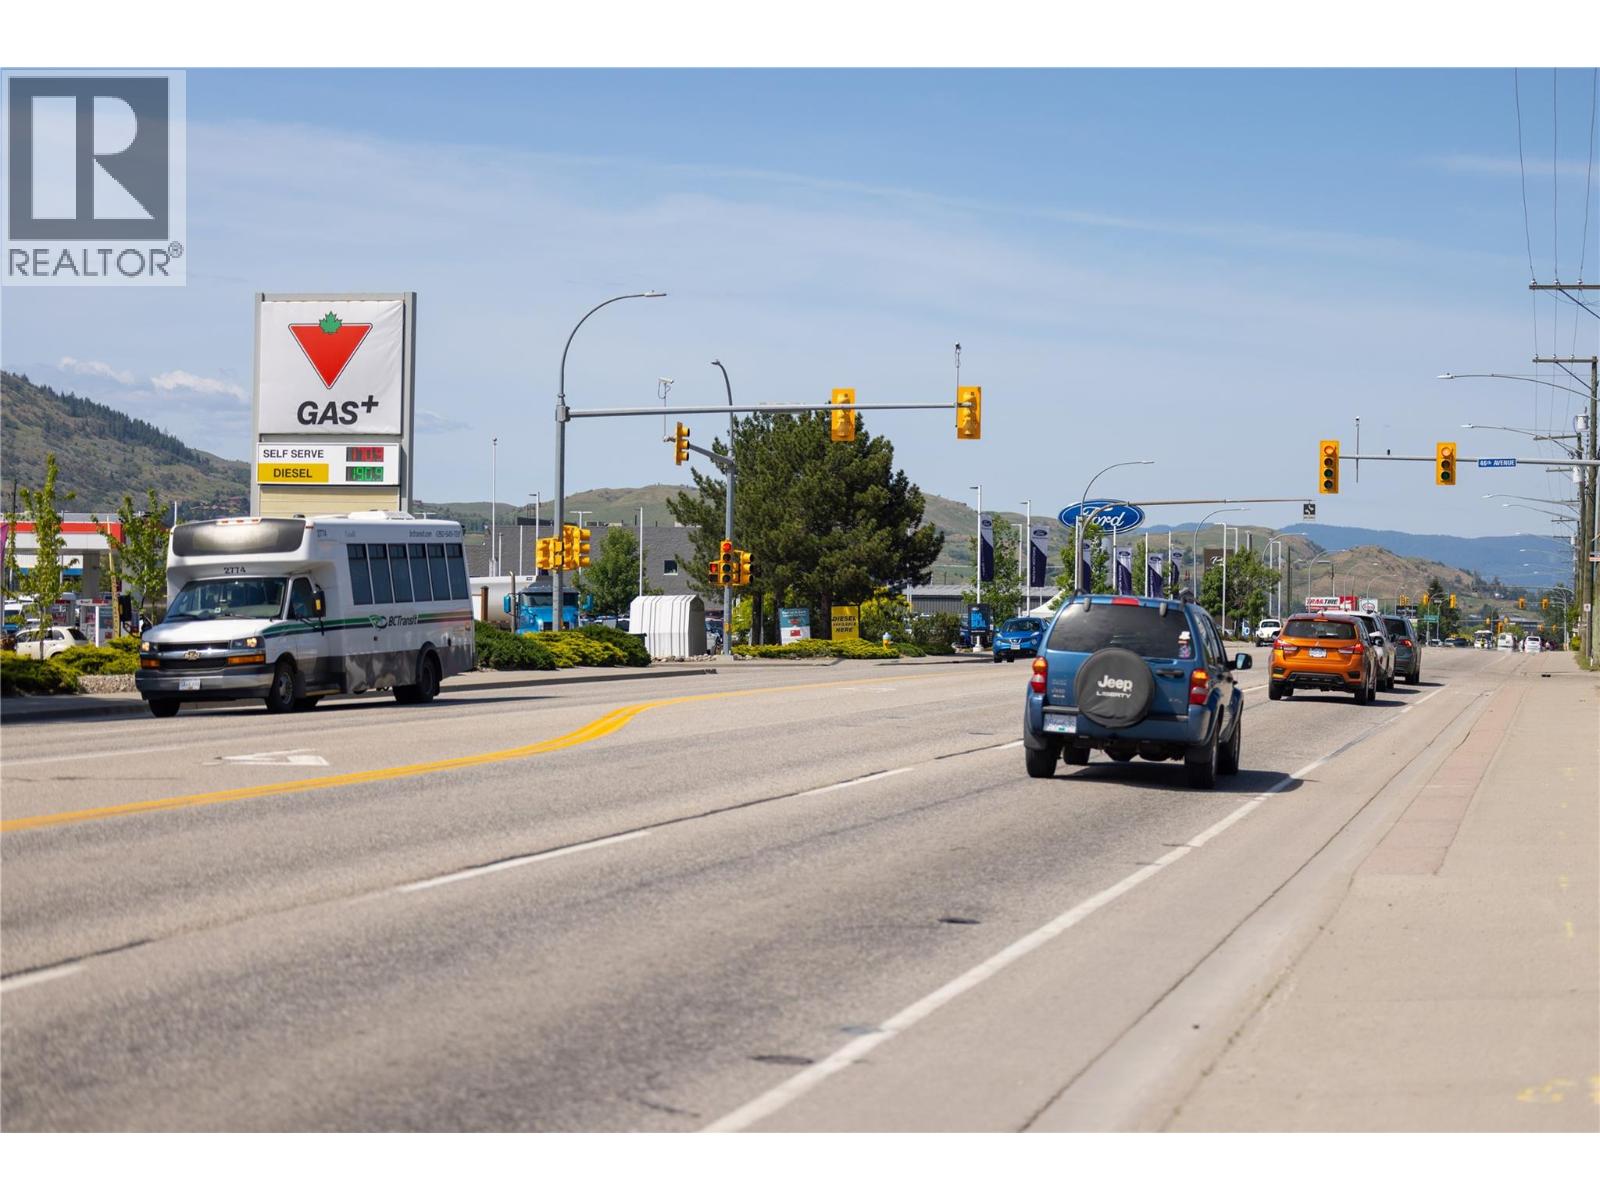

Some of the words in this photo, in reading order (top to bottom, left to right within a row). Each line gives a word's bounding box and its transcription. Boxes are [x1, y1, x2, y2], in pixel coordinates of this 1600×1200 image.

[263, 449, 288, 459] SELF
[290, 449, 324, 459] SERVE
[273, 468, 313, 478] DIESEL
[1082, 507, 1126, 527] Ford
[223, 566, 246, 575] 2774
[1097, 674, 1134, 692] Jeep
[1095, 690, 1132, 699] LIBERTY
